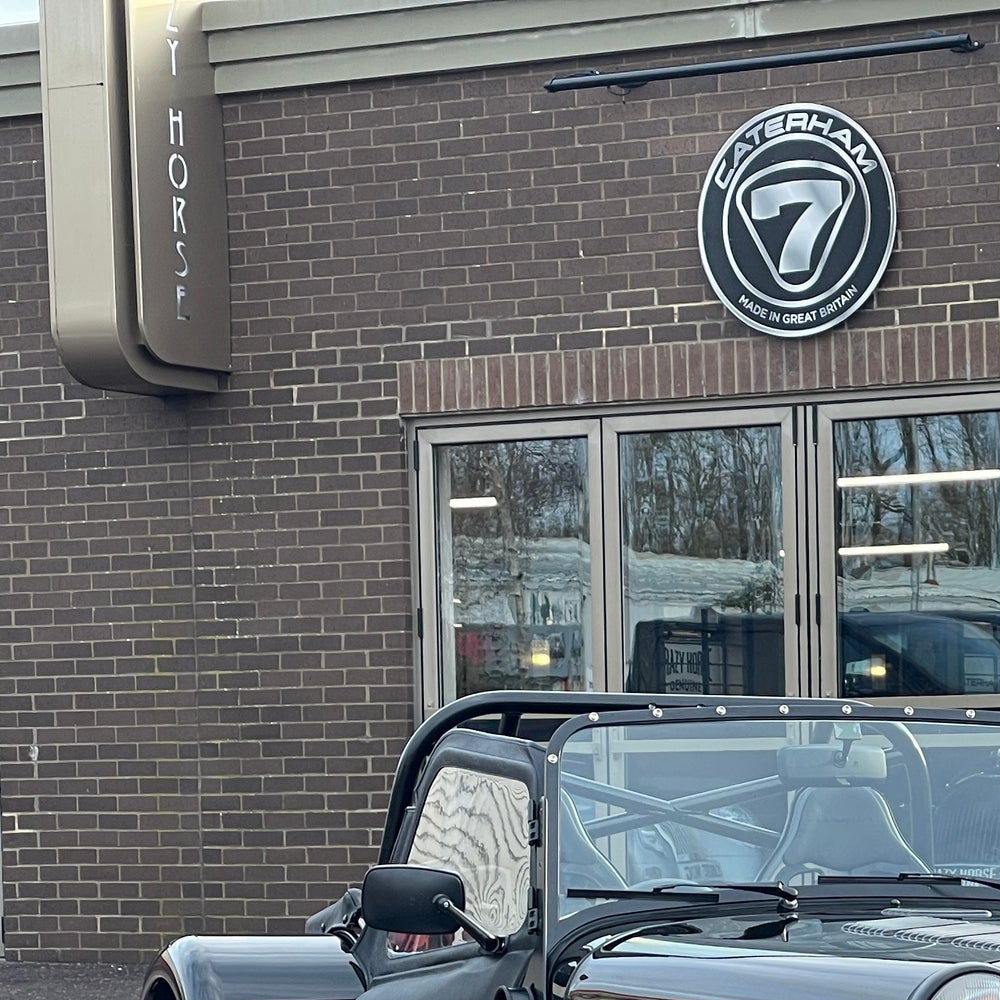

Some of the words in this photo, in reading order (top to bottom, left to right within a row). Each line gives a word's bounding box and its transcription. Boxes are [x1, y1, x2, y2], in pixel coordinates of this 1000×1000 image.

[714, 112, 878, 190] CATERHAM
[167, 107, 190, 321] HORSE
[751, 179, 843, 274] 7
[738, 294, 769, 319] MADE
[768, 310, 781, 323] IN
[782, 310, 818, 325] GREAT
[819, 284, 859, 318] BRITAIN
